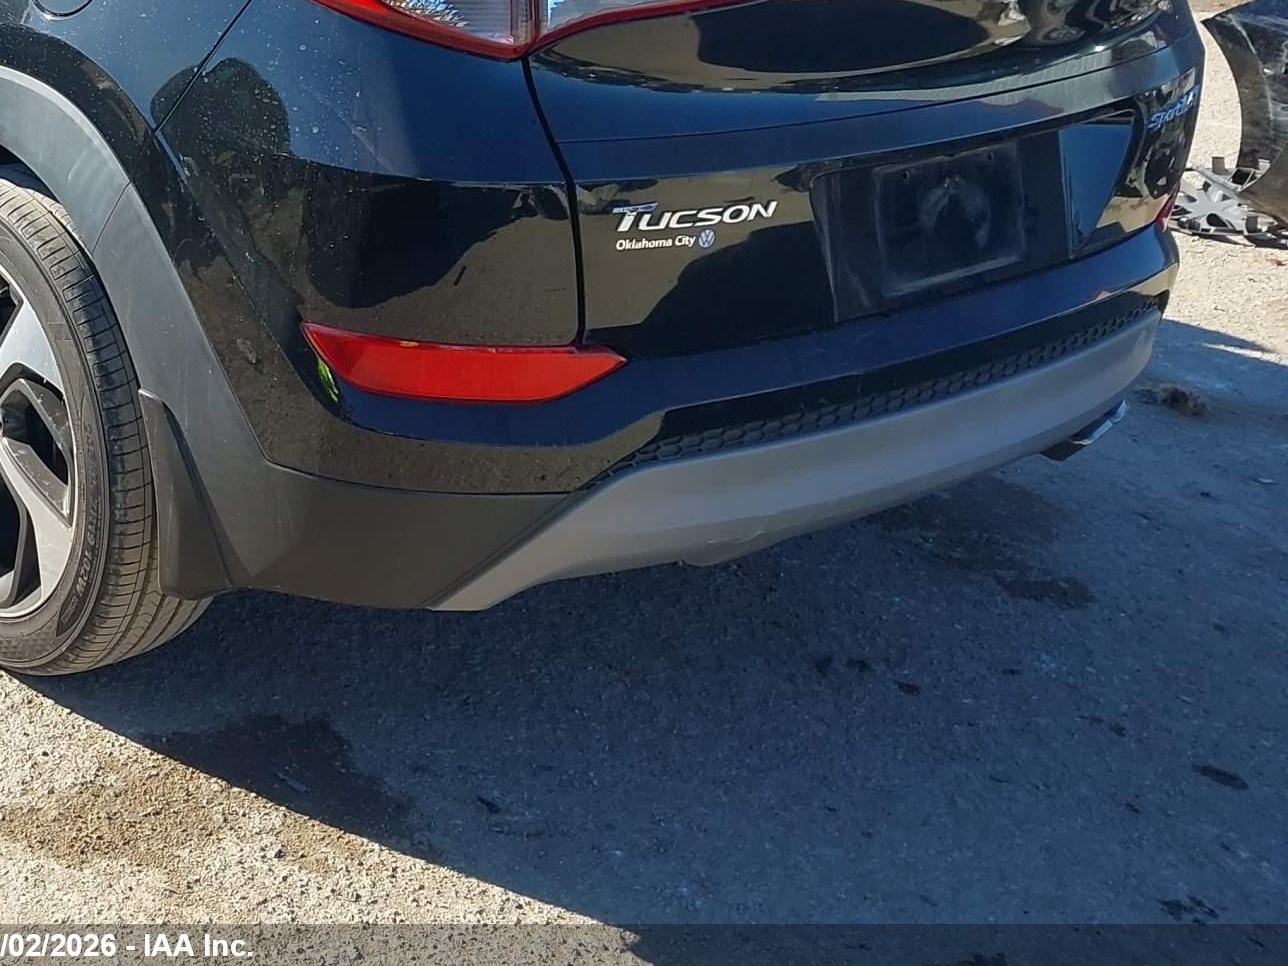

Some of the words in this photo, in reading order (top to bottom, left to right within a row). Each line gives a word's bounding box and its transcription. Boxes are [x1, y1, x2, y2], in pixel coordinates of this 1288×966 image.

[613, 202, 778, 232] TUCSON
[616, 238, 673, 251] Oklahoma
[675, 235, 697, 247] City
